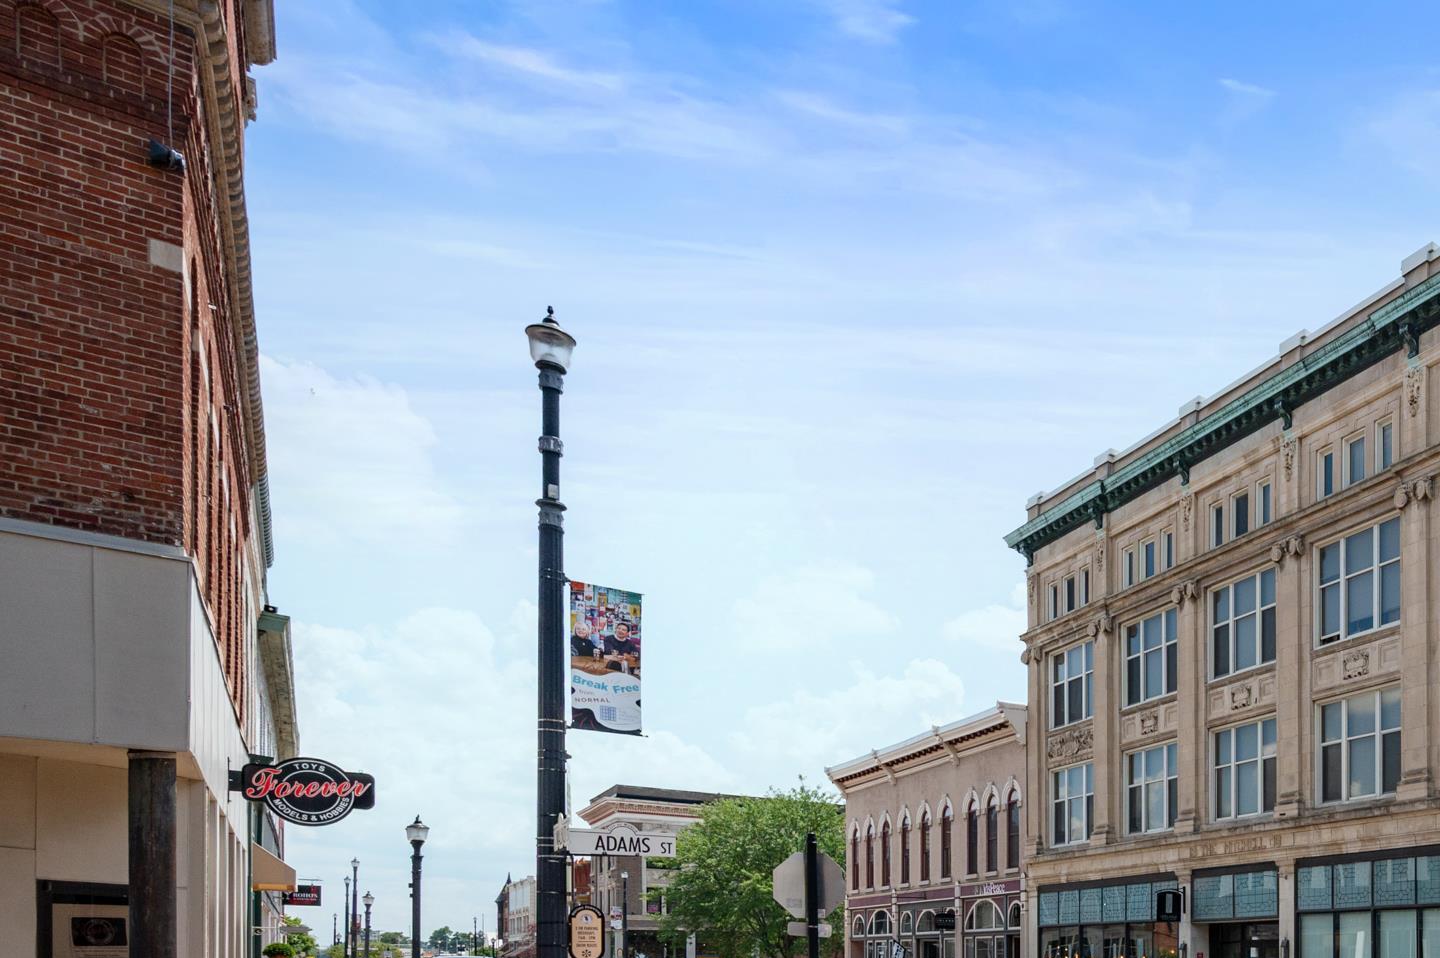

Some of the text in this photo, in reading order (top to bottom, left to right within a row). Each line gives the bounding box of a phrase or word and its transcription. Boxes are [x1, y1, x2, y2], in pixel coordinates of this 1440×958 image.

[572, 675, 639, 694] Break Free
[294, 763, 325, 772] TOYS
[246, 768, 371, 798] Forever
[273, 798, 308, 821] MODELS
[320, 797, 350, 820] HOBBIES
[595, 836, 672, 854] ADAMS ST
